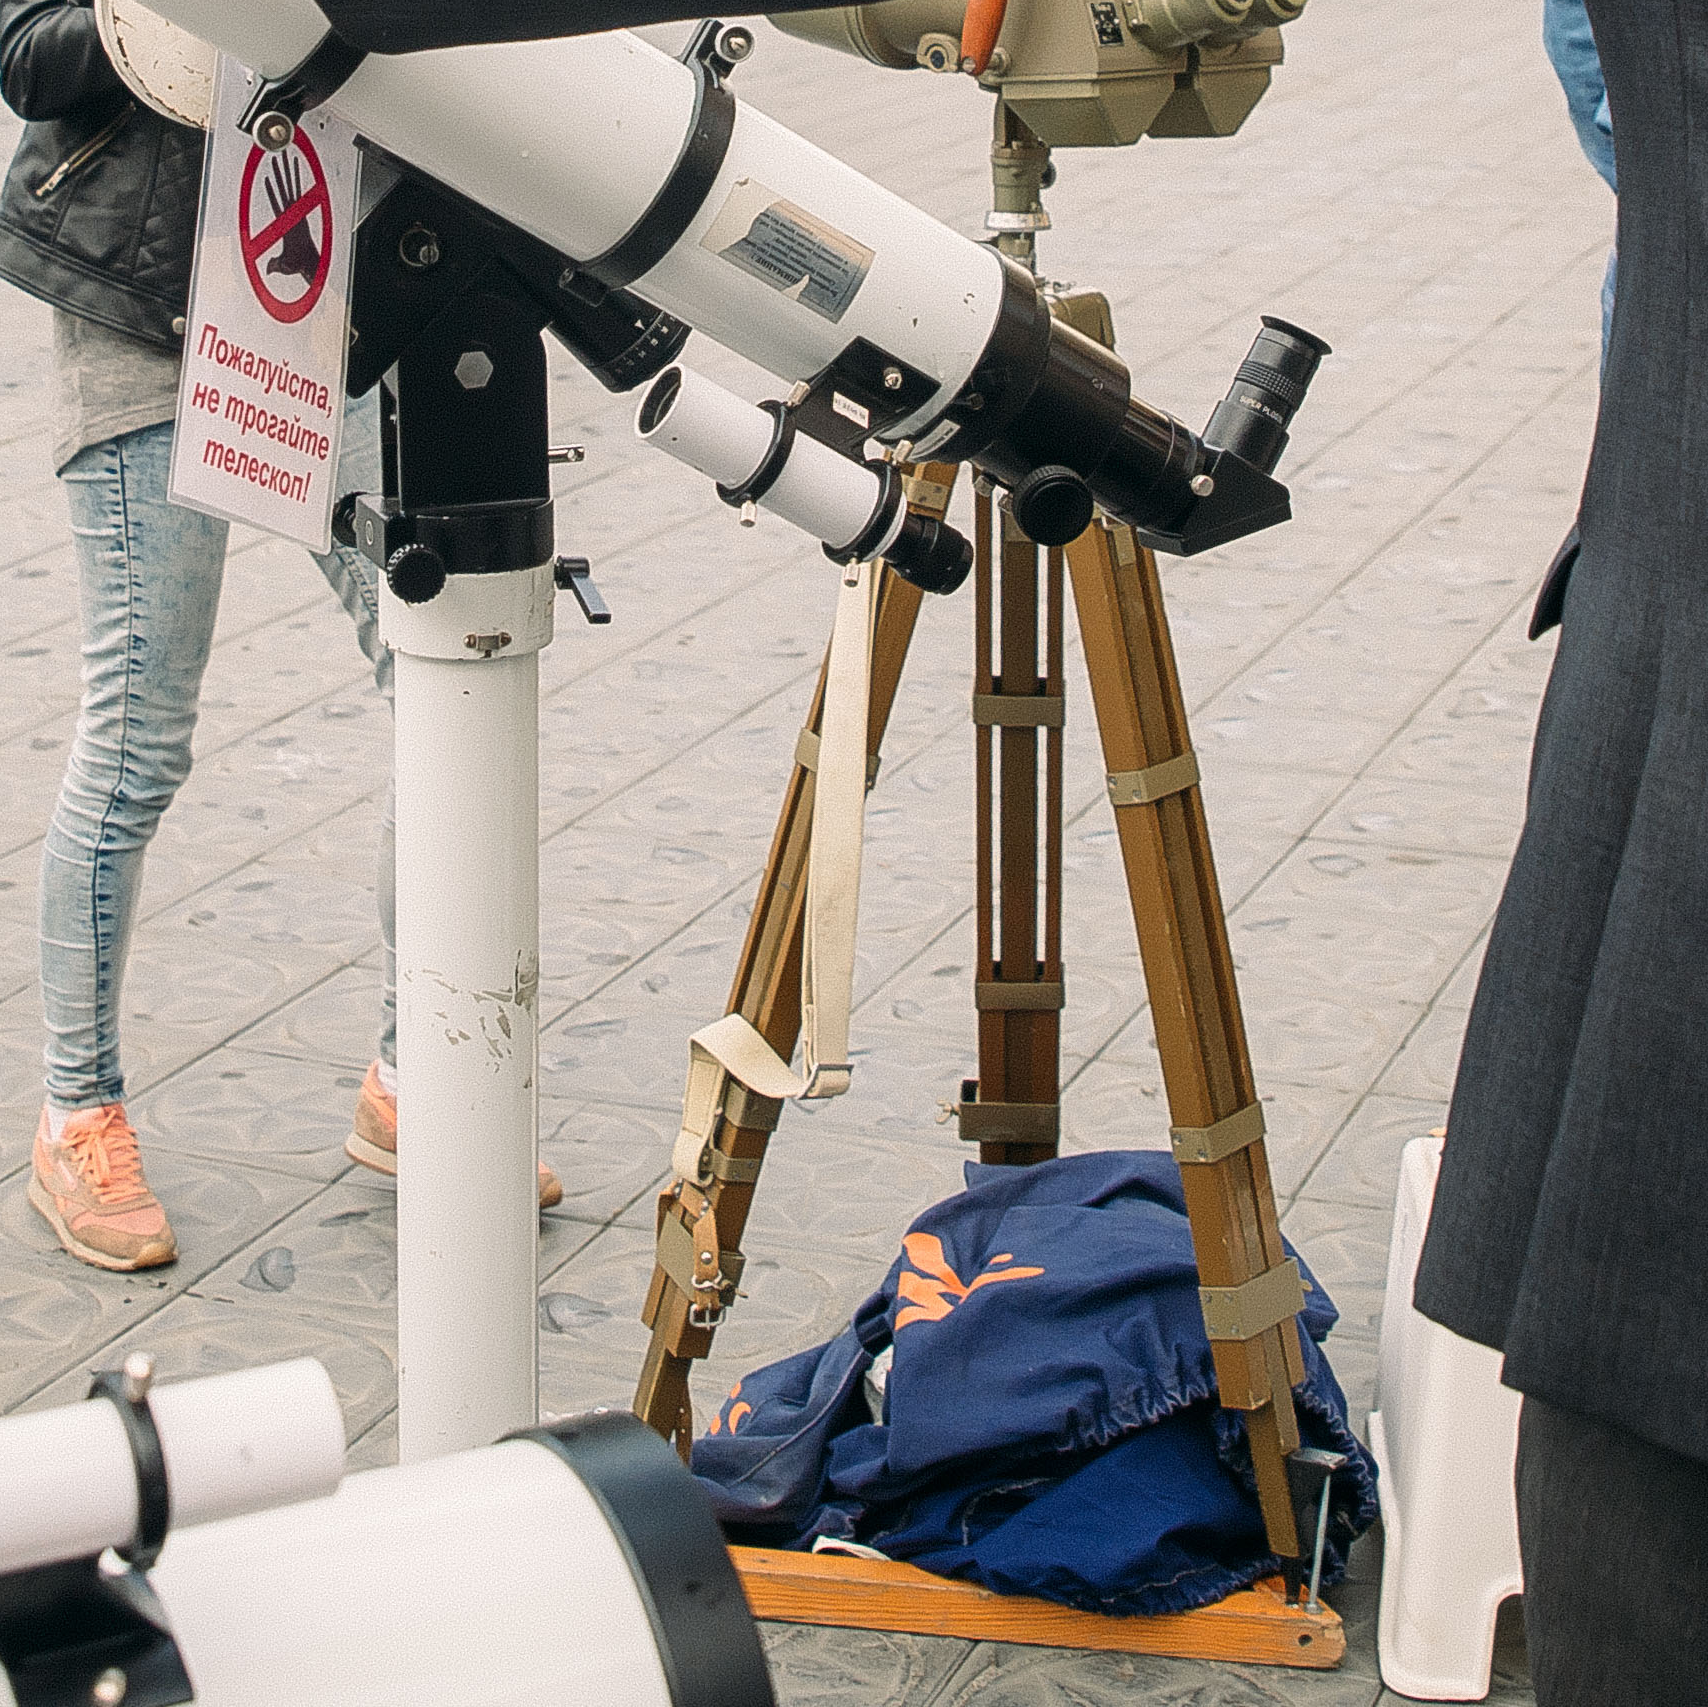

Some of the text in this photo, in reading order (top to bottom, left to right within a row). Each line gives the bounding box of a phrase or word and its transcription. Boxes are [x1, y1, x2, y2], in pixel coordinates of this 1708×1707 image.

[197, 323, 333, 419] Пожалуйста,
[192, 382, 330, 461] не трогайте
[203, 439, 312, 504] телескоп!
